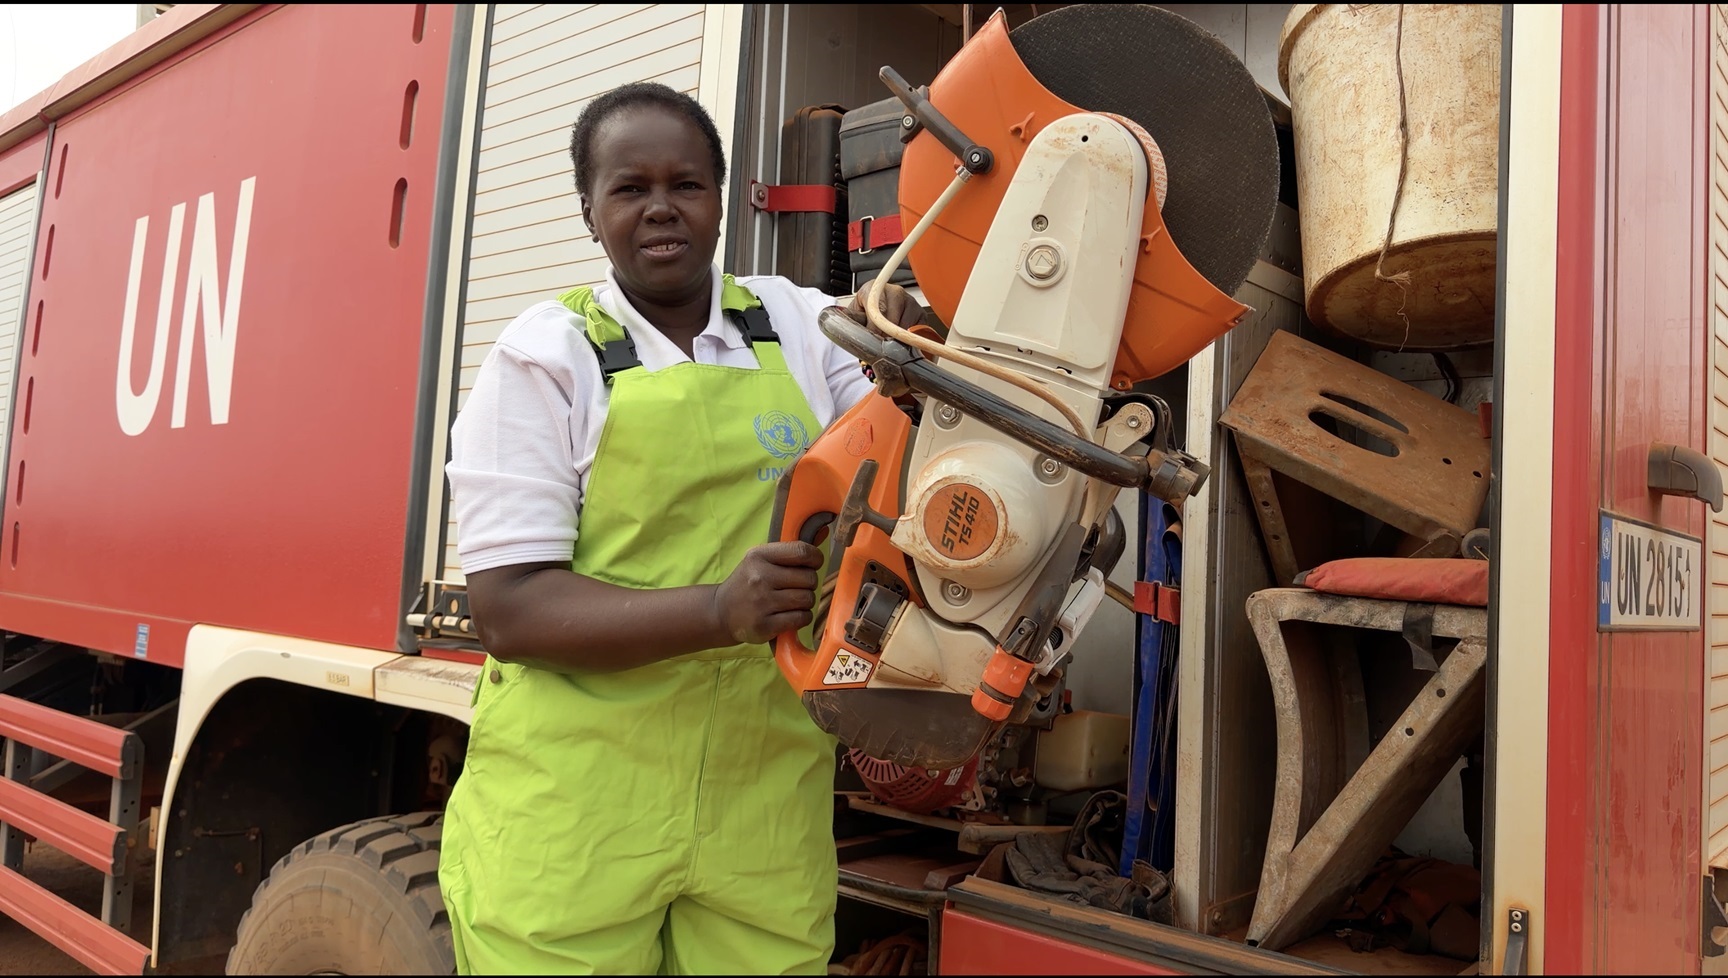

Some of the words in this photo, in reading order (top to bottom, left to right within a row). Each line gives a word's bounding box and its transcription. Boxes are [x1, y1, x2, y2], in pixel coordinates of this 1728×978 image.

[115, 175, 257, 437] UN
[941, 491, 968, 553] STIHL
[965, 496, 980, 526] 410
[959, 524, 972, 546] TS
[1601, 580, 1610, 605] UN
[1617, 532, 1642, 616] UN
